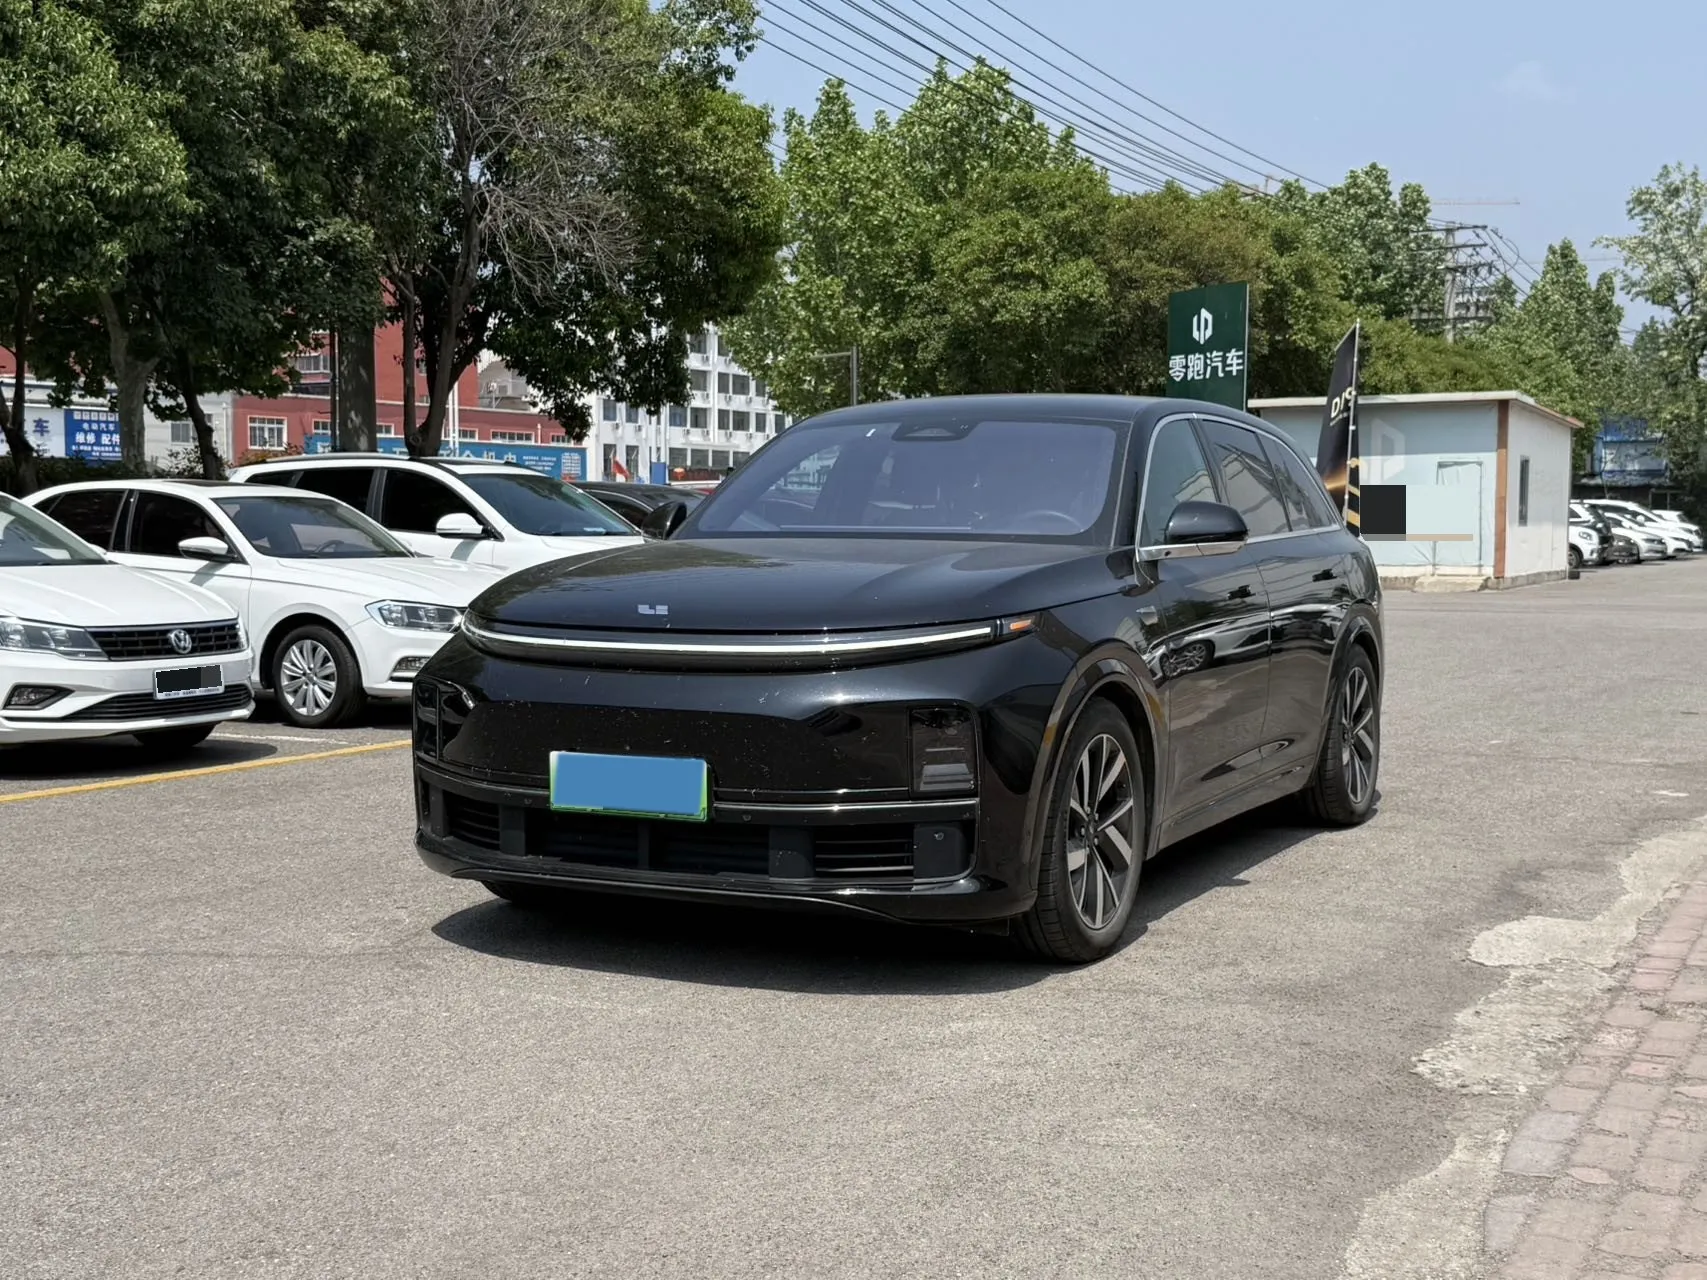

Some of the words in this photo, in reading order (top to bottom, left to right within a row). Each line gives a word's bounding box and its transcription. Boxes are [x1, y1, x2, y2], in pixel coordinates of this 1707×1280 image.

[1168, 347, 1244, 382] 零跑汽车
[33, 418, 50, 436] 车
[75, 431, 96, 444] 维修
[101, 433, 120, 445] 配件
